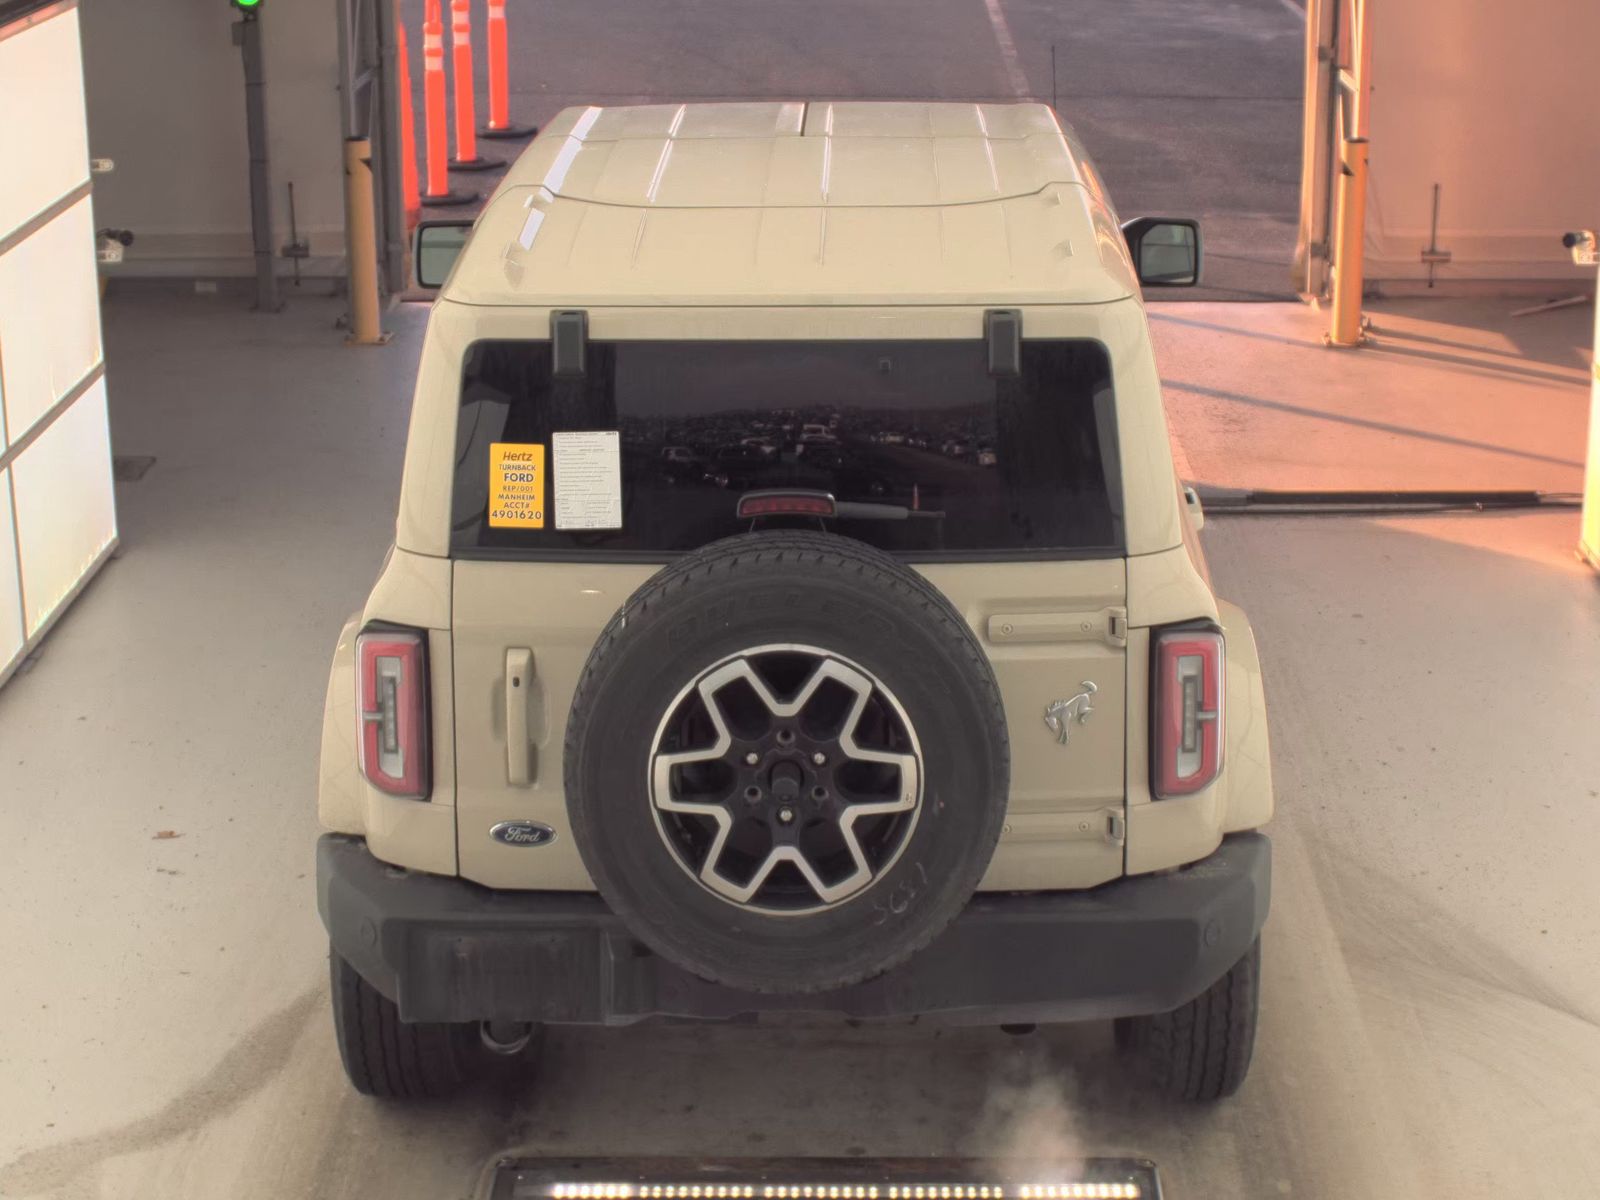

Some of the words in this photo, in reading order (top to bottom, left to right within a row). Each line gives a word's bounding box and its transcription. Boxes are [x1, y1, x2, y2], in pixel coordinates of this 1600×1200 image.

[502, 451, 533, 461] Hertz
[504, 473, 534, 482] FORD
[492, 510, 542, 520] 4901620
[505, 826, 541, 842] Ford
